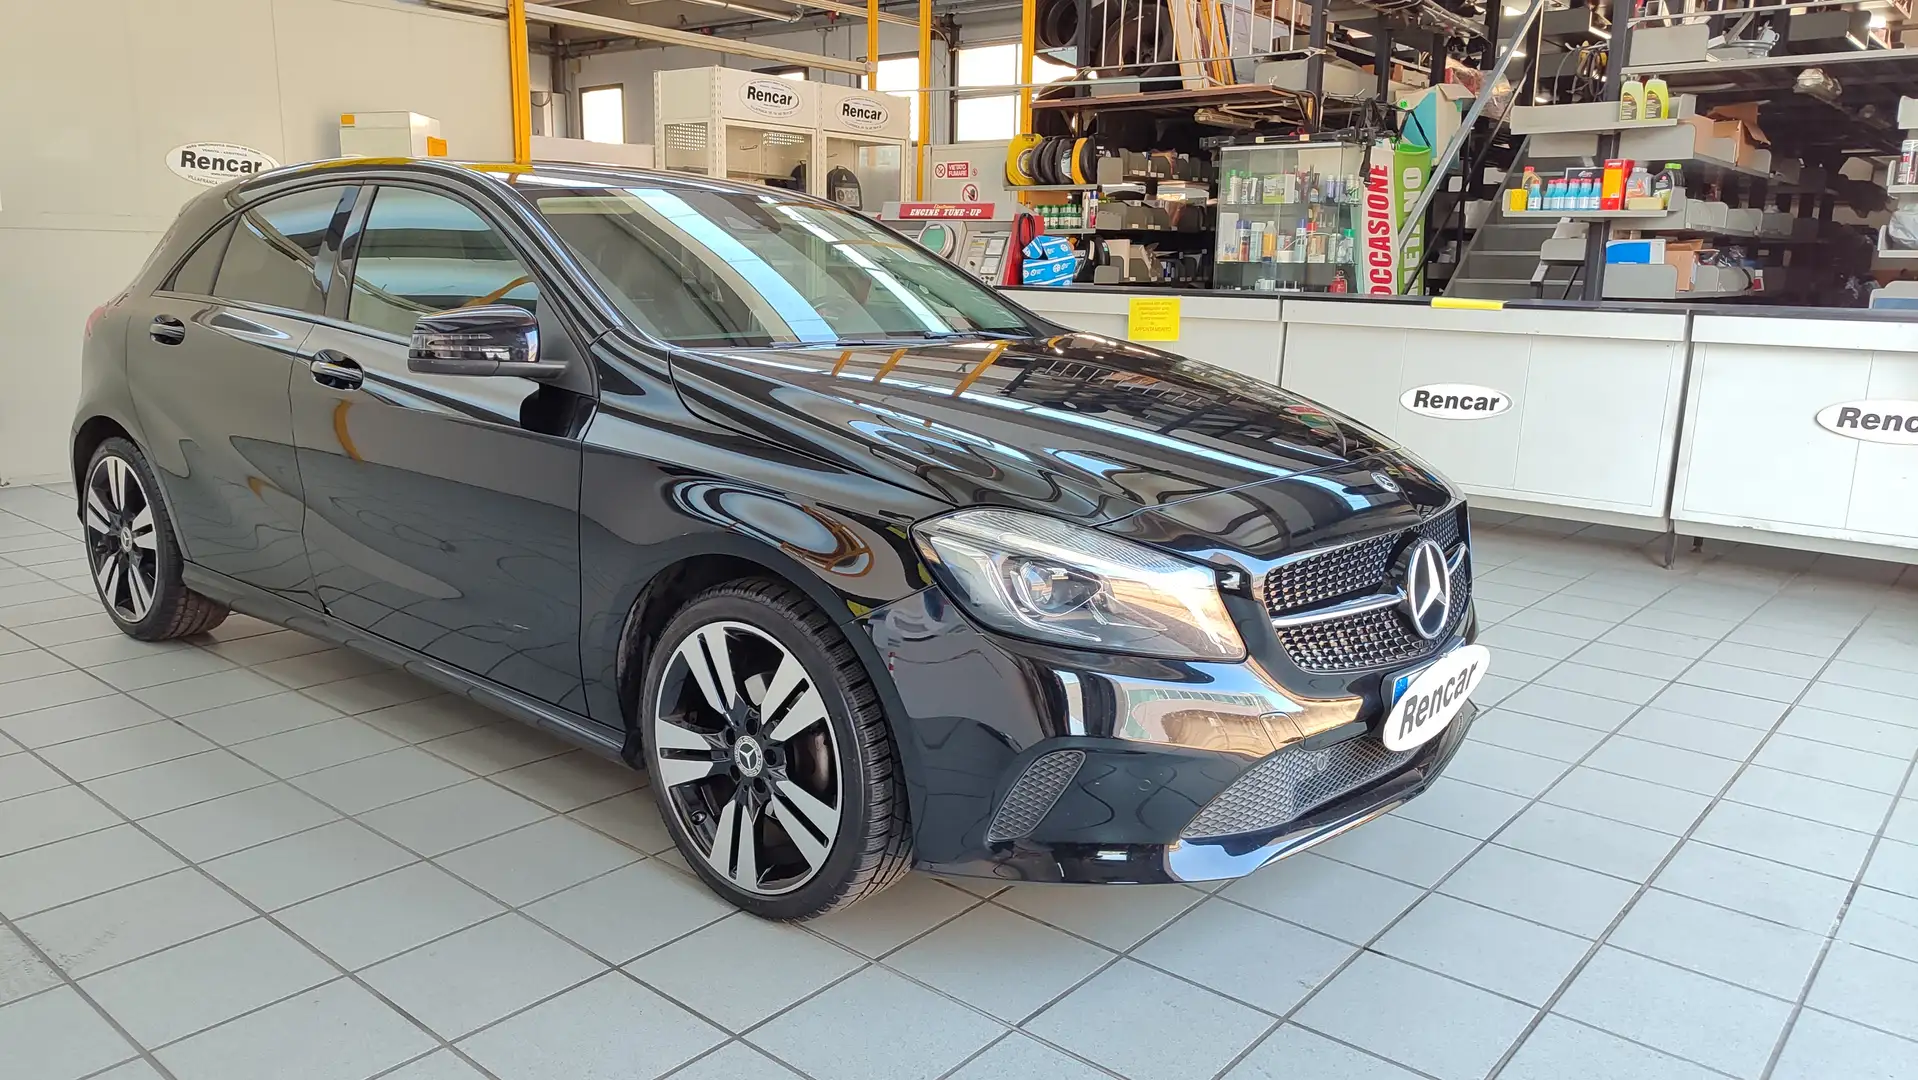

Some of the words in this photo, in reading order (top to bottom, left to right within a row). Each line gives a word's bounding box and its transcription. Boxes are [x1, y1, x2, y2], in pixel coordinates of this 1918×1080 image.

[747, 85, 792, 105] Rencar
[842, 103, 882, 120] Rencar
[180, 150, 262, 174] Rencar
[187, 174, 218, 185] VILLAFRANCA
[909, 208, 939, 217] ENGINE
[1413, 389, 1500, 411] Rencar
[1836, 406, 1918, 433] Renc
[1398, 660, 1479, 741] Rencar
